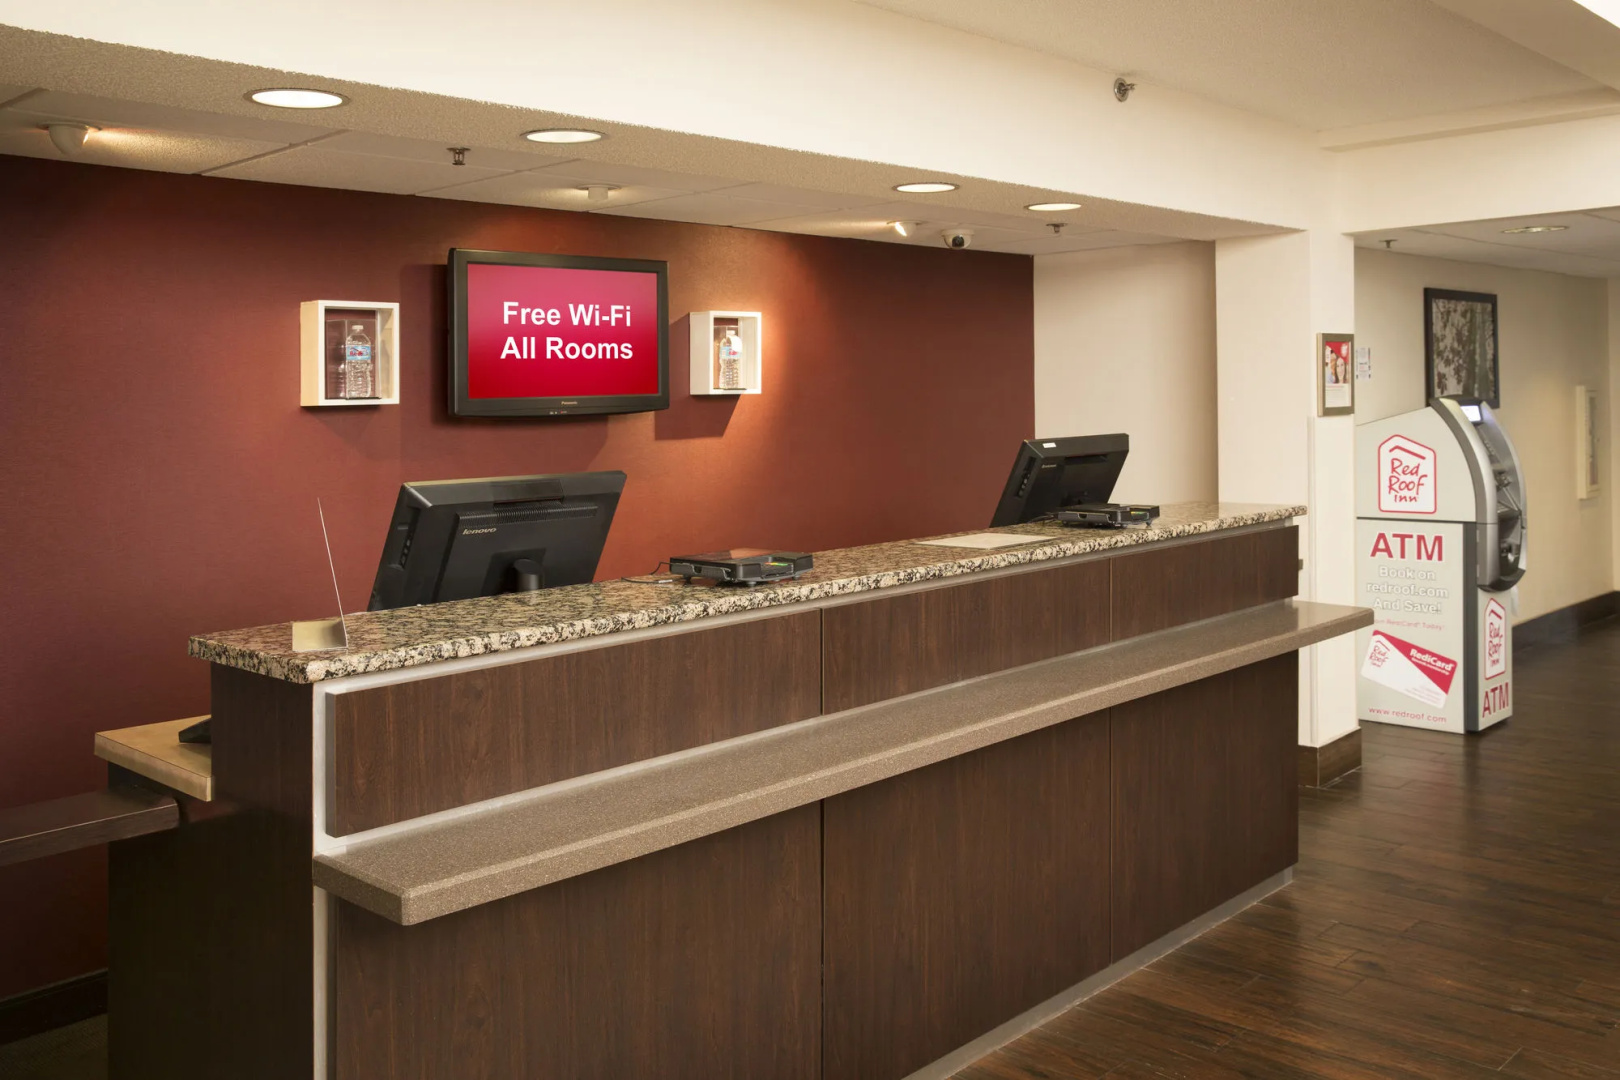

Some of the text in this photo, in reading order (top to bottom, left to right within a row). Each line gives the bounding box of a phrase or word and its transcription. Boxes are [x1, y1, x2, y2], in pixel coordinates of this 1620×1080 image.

[503, 301, 631, 327] Free Wi-Fi
[500, 336, 633, 360] All Rooms
[1391, 458, 1420, 477] Red
[1388, 474, 1428, 496] Roof
[462, 527, 497, 535] lenovo
[1370, 532, 1443, 562] ATM
[1378, 566, 1436, 581] Book on
[1366, 582, 1449, 598] redroof.com
[1373, 598, 1442, 615] And Save!
[1482, 682, 1510, 718] ATM
